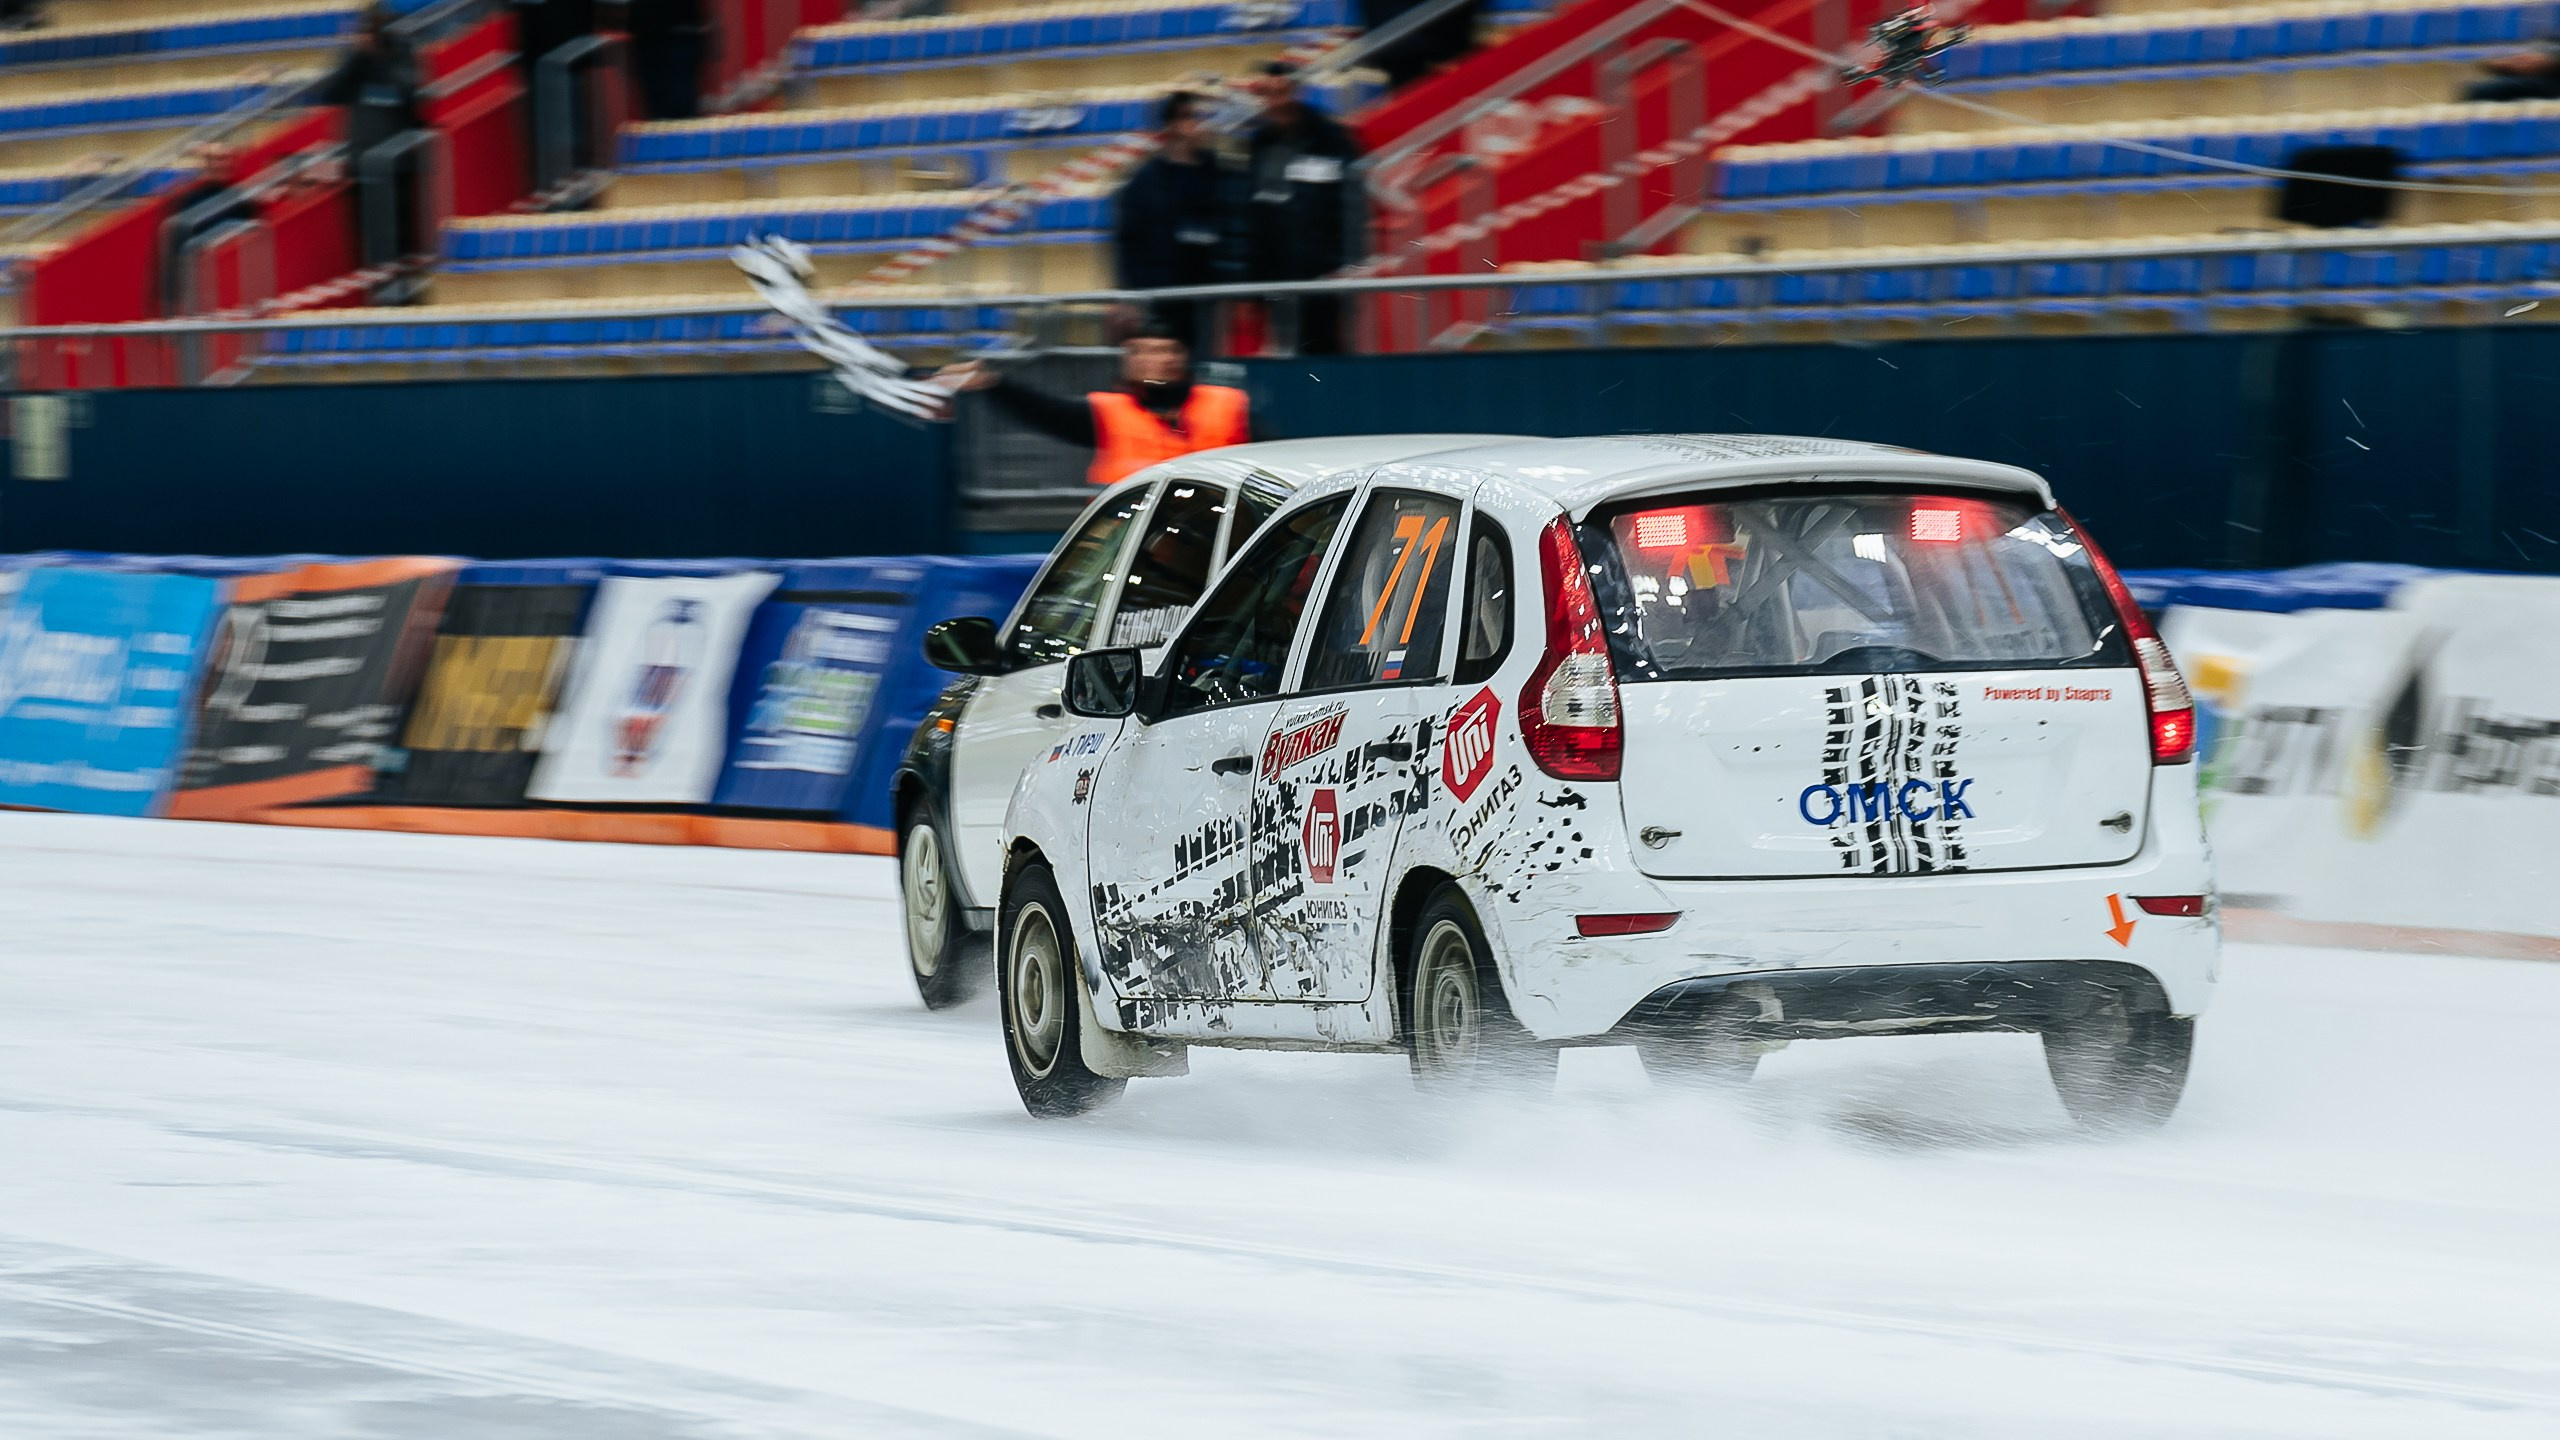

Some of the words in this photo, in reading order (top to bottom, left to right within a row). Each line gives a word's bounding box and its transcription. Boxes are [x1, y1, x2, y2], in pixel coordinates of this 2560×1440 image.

[1359, 516, 1450, 645] 71
[1984, 686, 2042, 701] Powered
[2045, 687, 2060, 702] by
[1285, 699, 1346, 729] vulkan-omsk.ru
[1260, 712, 1347, 784] Вулкан
[1799, 777, 1976, 826] ОМСК
[1305, 899, 1348, 920] ЮНИГАЗ
